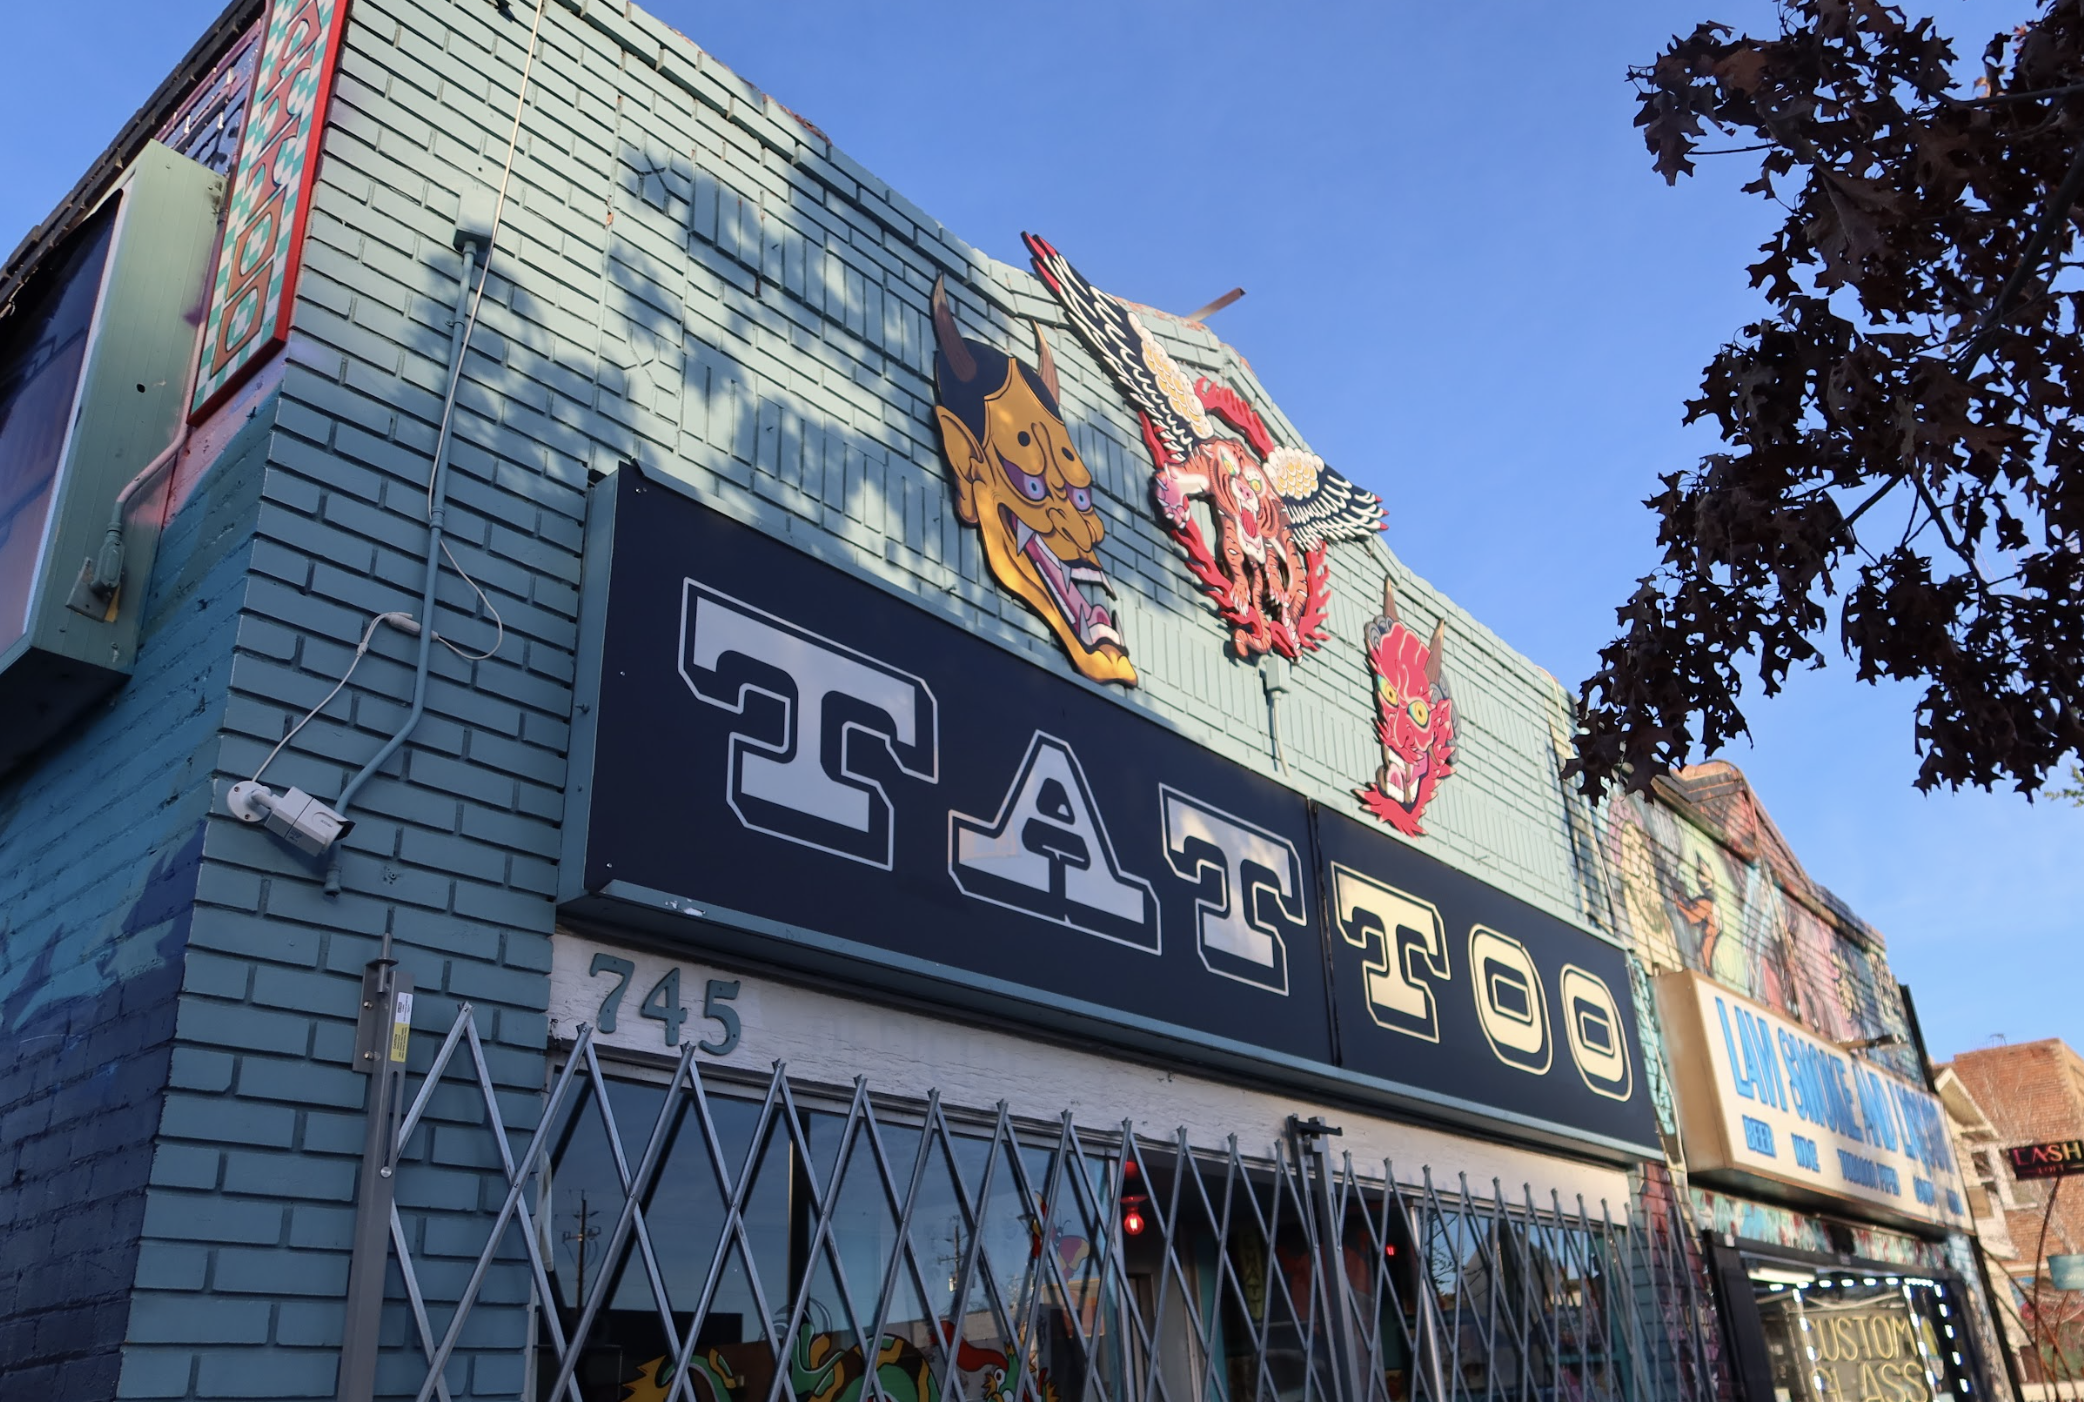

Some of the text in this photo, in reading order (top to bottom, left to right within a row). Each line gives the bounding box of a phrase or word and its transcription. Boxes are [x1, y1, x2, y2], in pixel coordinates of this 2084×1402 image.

[211, 0, 322, 376] ATTOO
[678, 576, 1634, 1103] TATTOO
[589, 952, 742, 1057] 745
[1778, 1026, 1864, 1144] SMOKE
[1852, 1060, 1899, 1152] AND
[1742, 1114, 1777, 1158] BEER
[1791, 1132, 1821, 1173] WINE
[2013, 1142, 2082, 1166] LASH
[1801, 1315, 1918, 1362] CUSTOM
